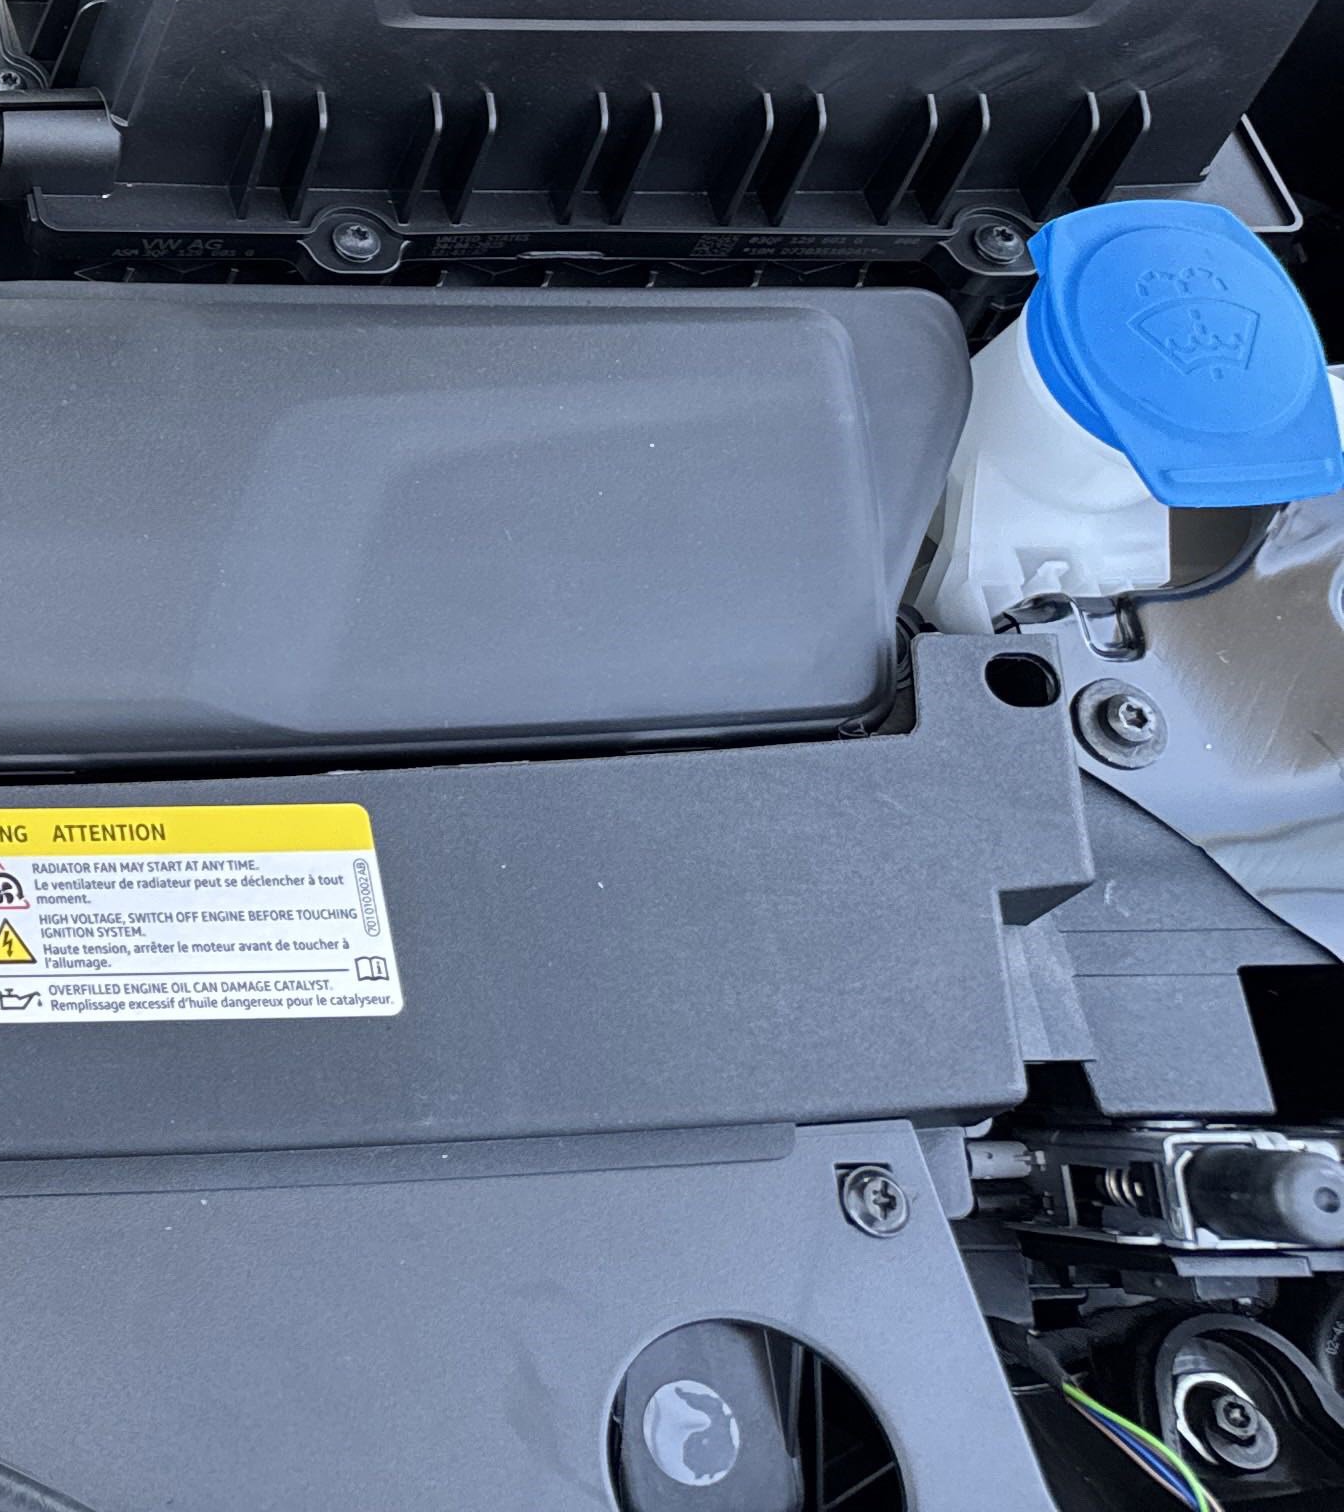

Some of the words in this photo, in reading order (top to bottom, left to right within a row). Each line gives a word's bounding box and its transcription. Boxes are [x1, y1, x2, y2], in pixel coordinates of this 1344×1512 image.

[52, 822, 166, 842] ATTENTION
[31, 861, 91, 874] RADIATOR
[92, 861, 117, 873] FAN
[119, 861, 144, 873] MAY
[146, 860, 182, 872] START
[184, 860, 199, 871] AT
[200, 859, 225, 871] ANY
[225, 859, 259, 871] TIME.
[38, 912, 69, 925] HIGH
[69, 912, 126, 925] VOLTAGE,
[127, 911, 173, 924] SWITCH
[175, 910, 198, 923] OFF
[200, 909, 245, 922] ENGINE
[247, 909, 294, 922] BEFORE
[295, 907, 357, 920] TOUCHING
[40, 926, 94, 939] IGNITION
[96, 925, 146, 938] SYSTEM.
[47, 983, 121, 996] OVERFILLED
[122, 982, 169, 995] ENGINE
[170, 981, 191, 994] OIL
[192, 981, 218, 993] CAN
[220, 980, 271, 993] DAMAGE
